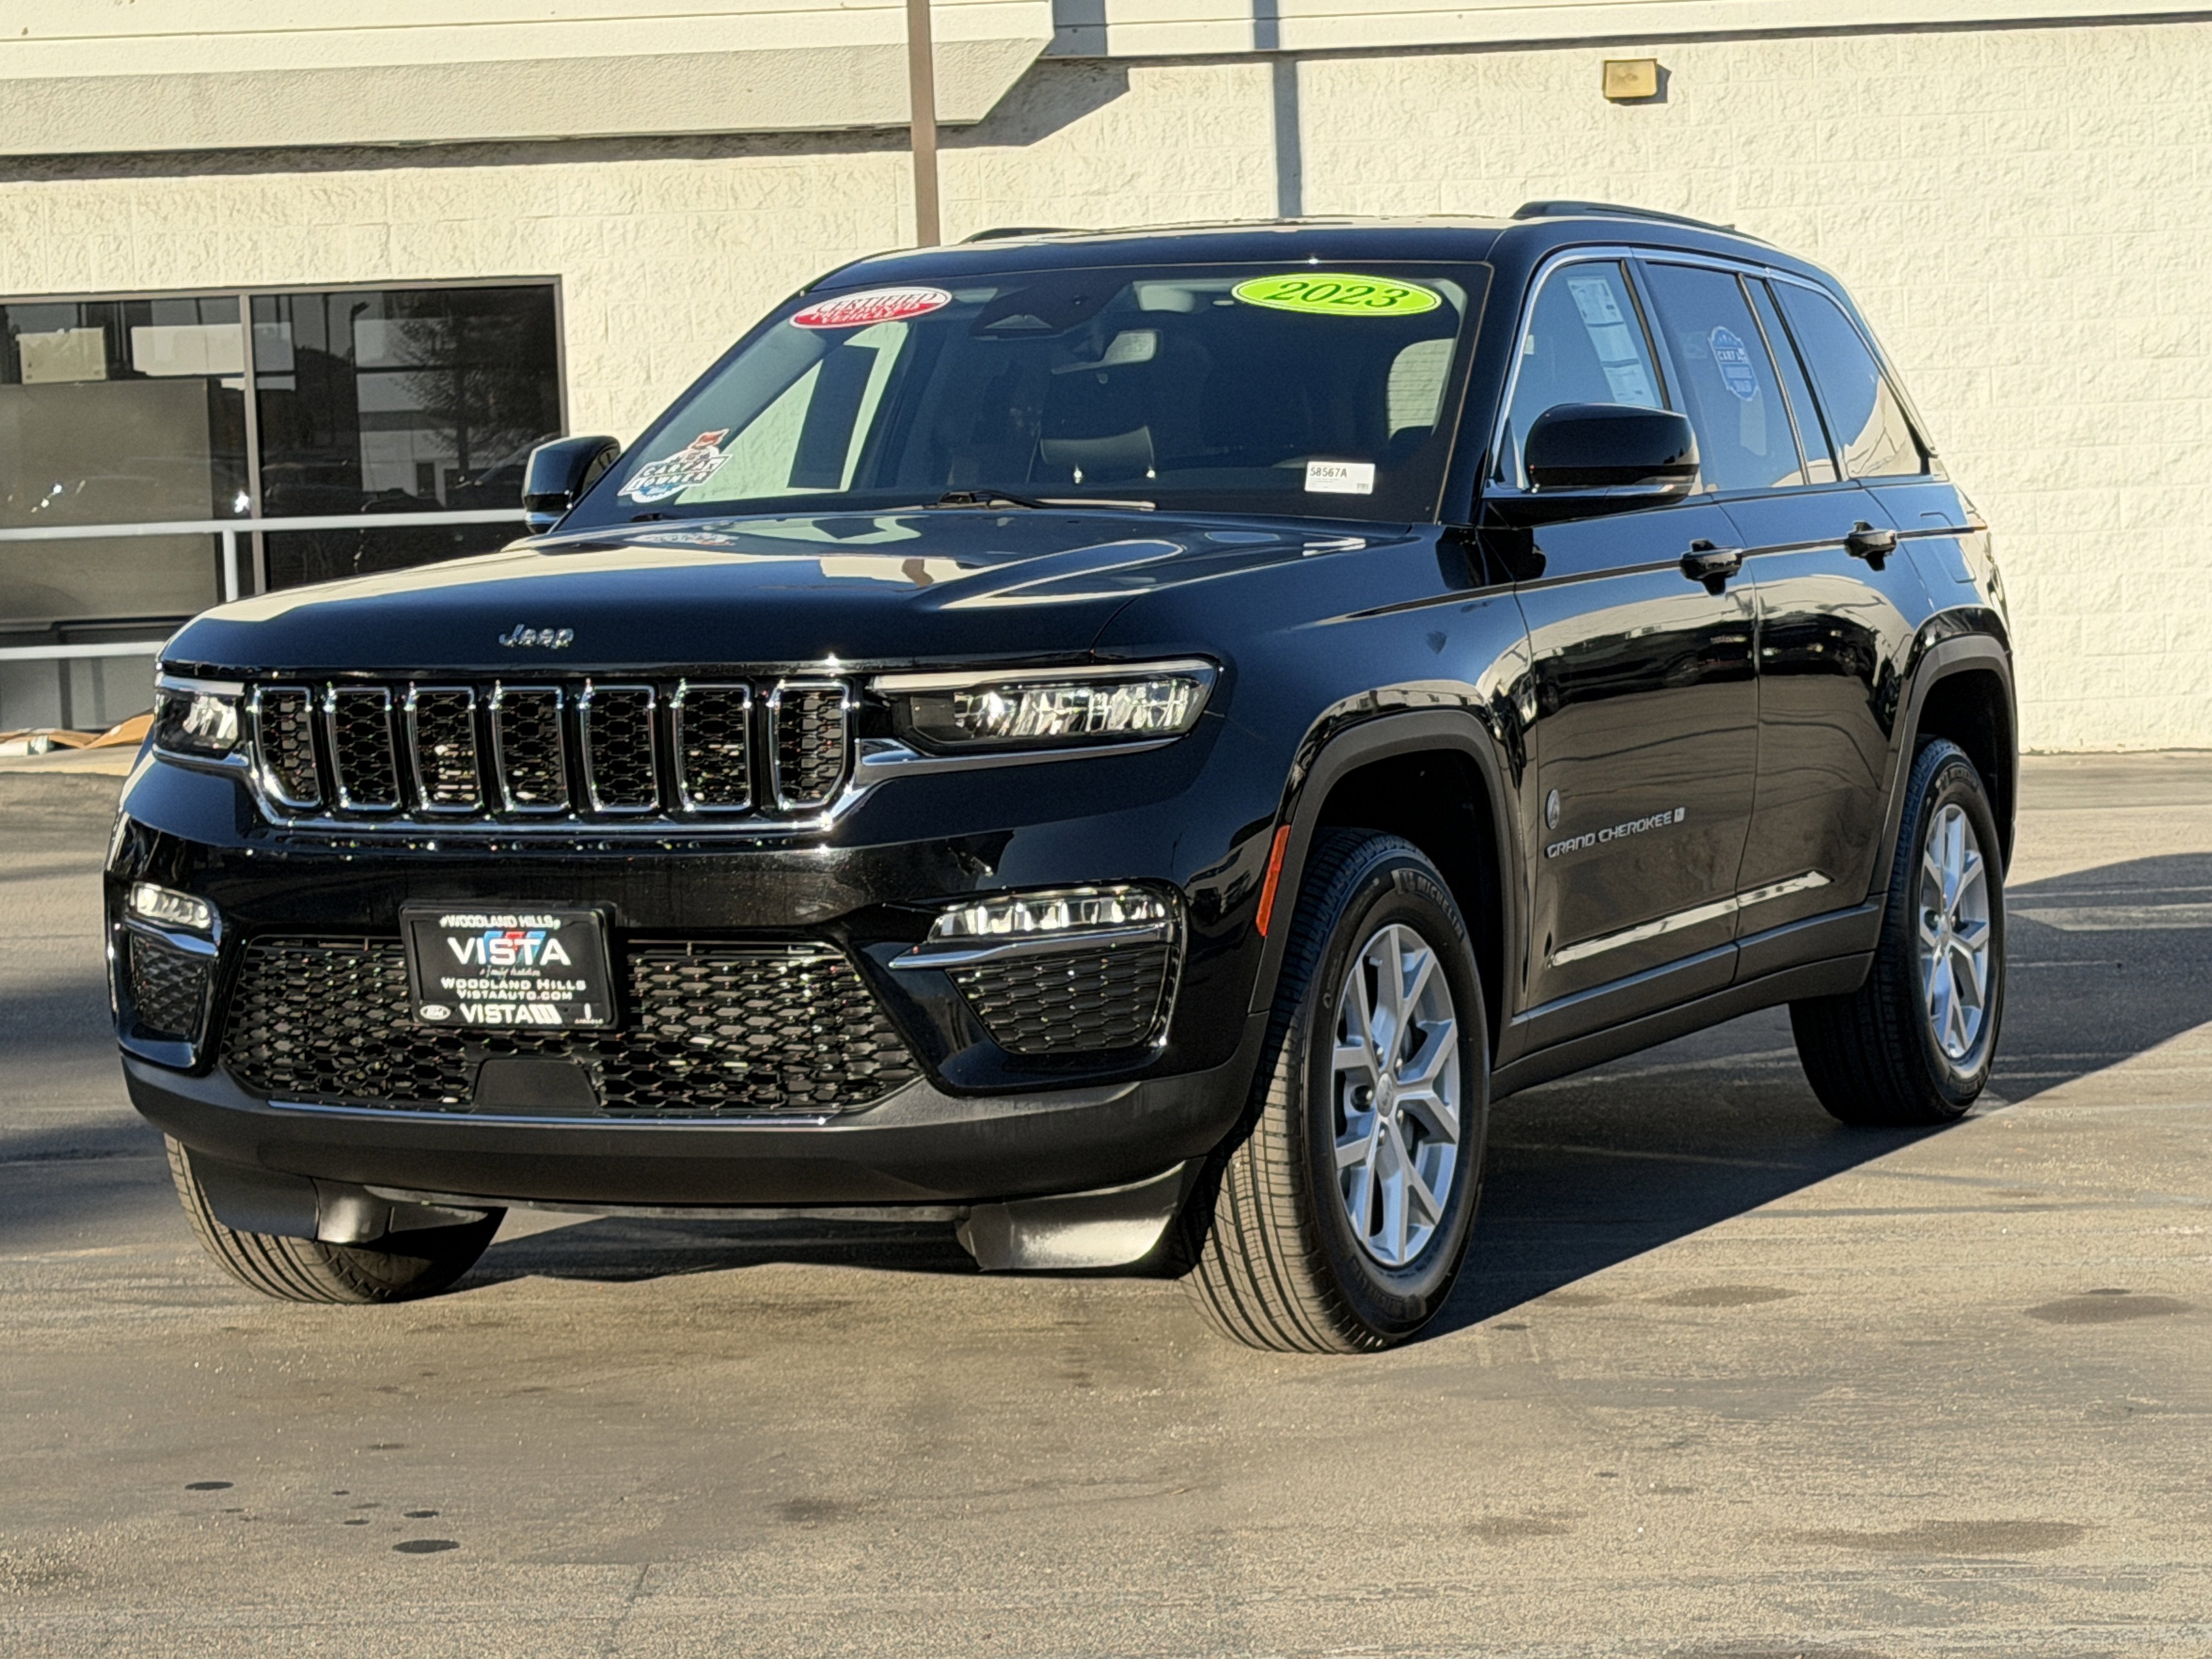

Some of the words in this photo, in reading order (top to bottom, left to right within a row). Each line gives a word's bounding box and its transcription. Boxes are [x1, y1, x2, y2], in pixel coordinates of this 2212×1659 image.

[816, 292, 938, 313] CERTIFIED
[1263, 281, 1410, 308] 2023
[499, 624, 574, 649] Jeep
[1547, 832, 1595, 859] GRAND
[1598, 810, 1672, 843] CHEROKEE
[1417, 876, 1463, 939] MICHELIN
[447, 937, 572, 966] VISTA
[441, 977, 532, 991] WOODLAND
[537, 978, 586, 991] HILLS
[459, 1003, 534, 1024] VISTA
